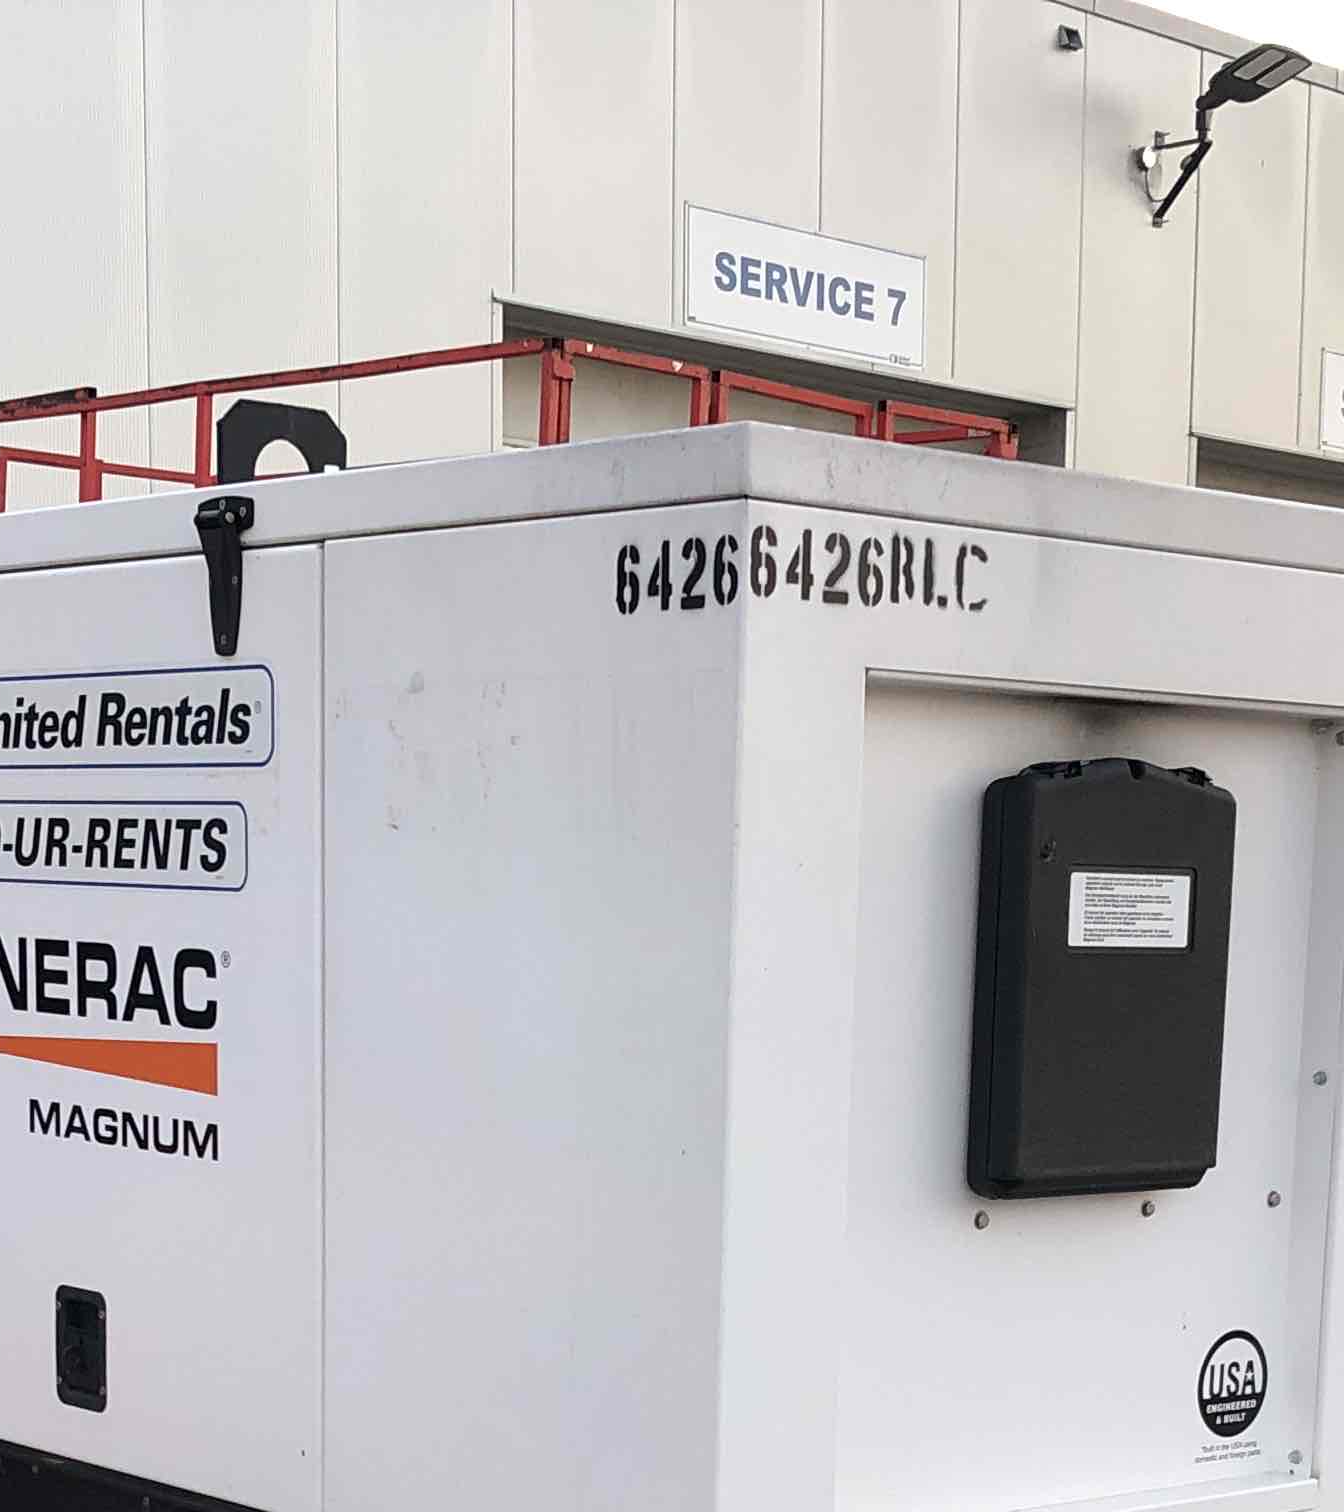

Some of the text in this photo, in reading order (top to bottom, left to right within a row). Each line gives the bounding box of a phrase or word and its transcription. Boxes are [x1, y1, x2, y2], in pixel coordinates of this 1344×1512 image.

[714, 252, 907, 326] SERVICE 7
[616, 534, 739, 615] 6426
[96, 688, 252, 748] Rentals
[29, 1098, 220, 1161] MAGNUM
[1206, 1399, 1257, 1414] ENGINEERED
[1209, 1360, 1257, 1399] USA
